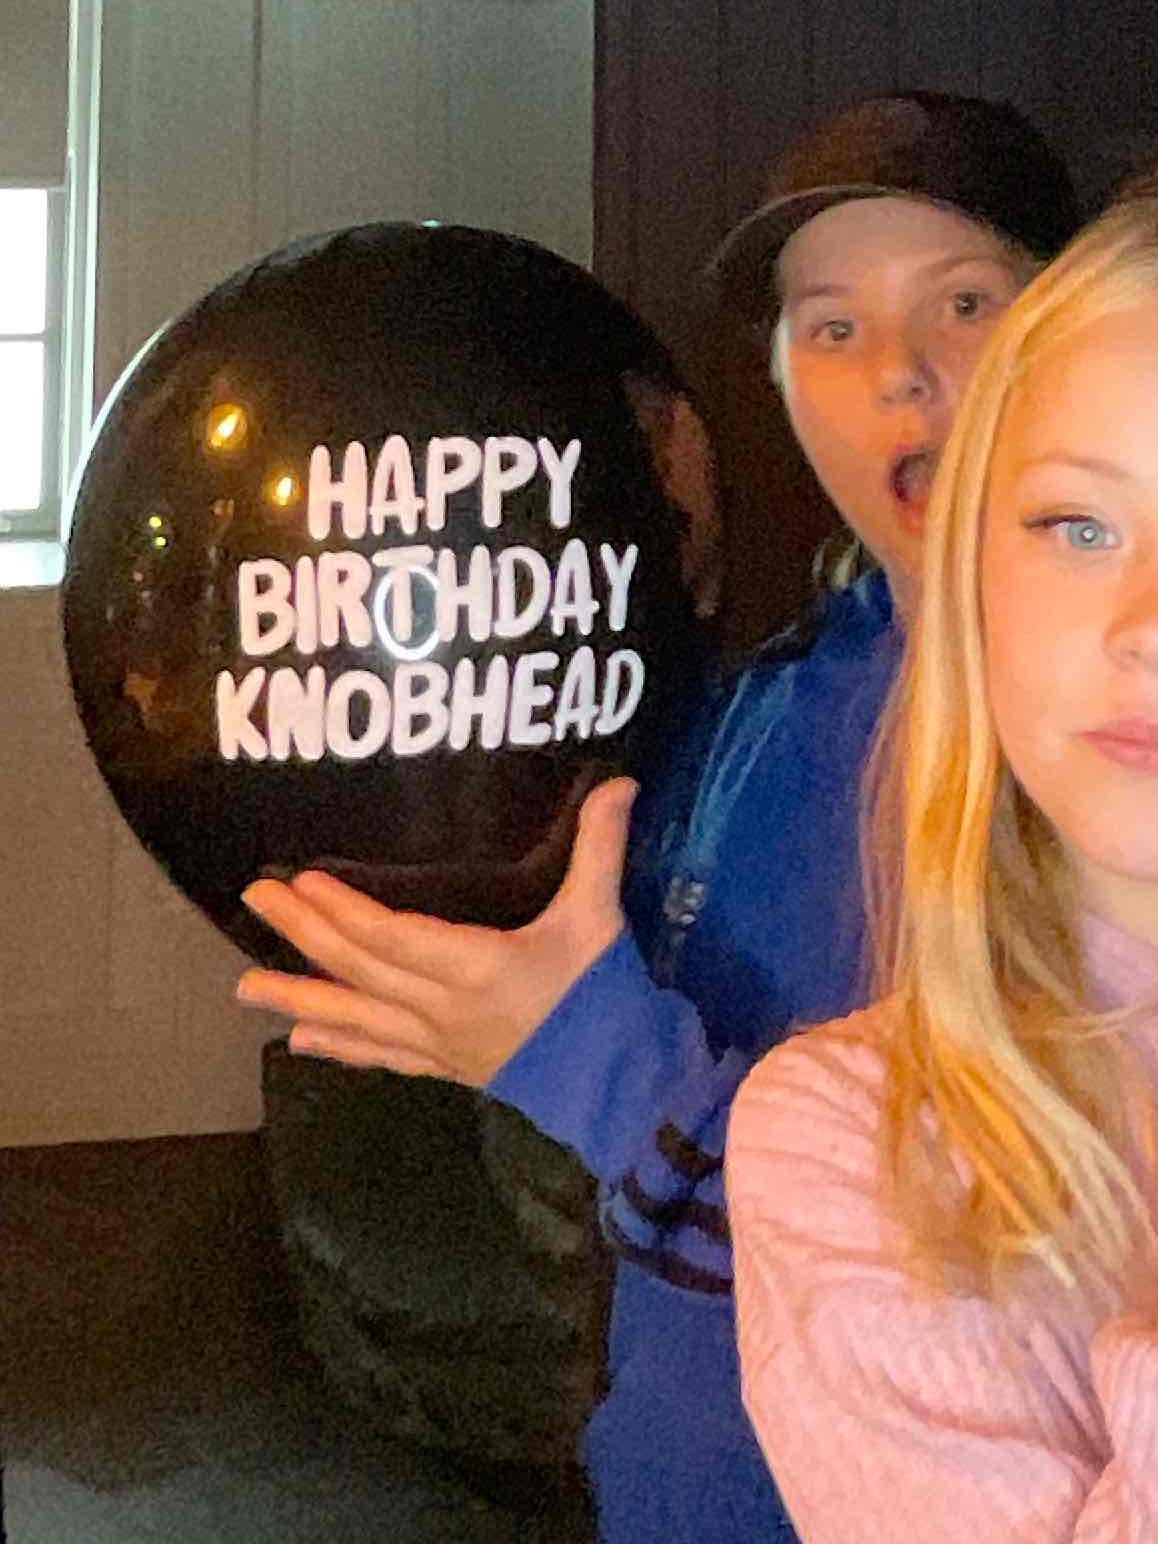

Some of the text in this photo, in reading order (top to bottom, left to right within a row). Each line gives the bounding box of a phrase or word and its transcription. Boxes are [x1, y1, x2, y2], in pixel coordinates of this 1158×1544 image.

[309, 435, 582, 538] HAPPY
[238, 540, 639, 656] BIRTHDAY
[214, 647, 645, 760] KNOBHEAD
